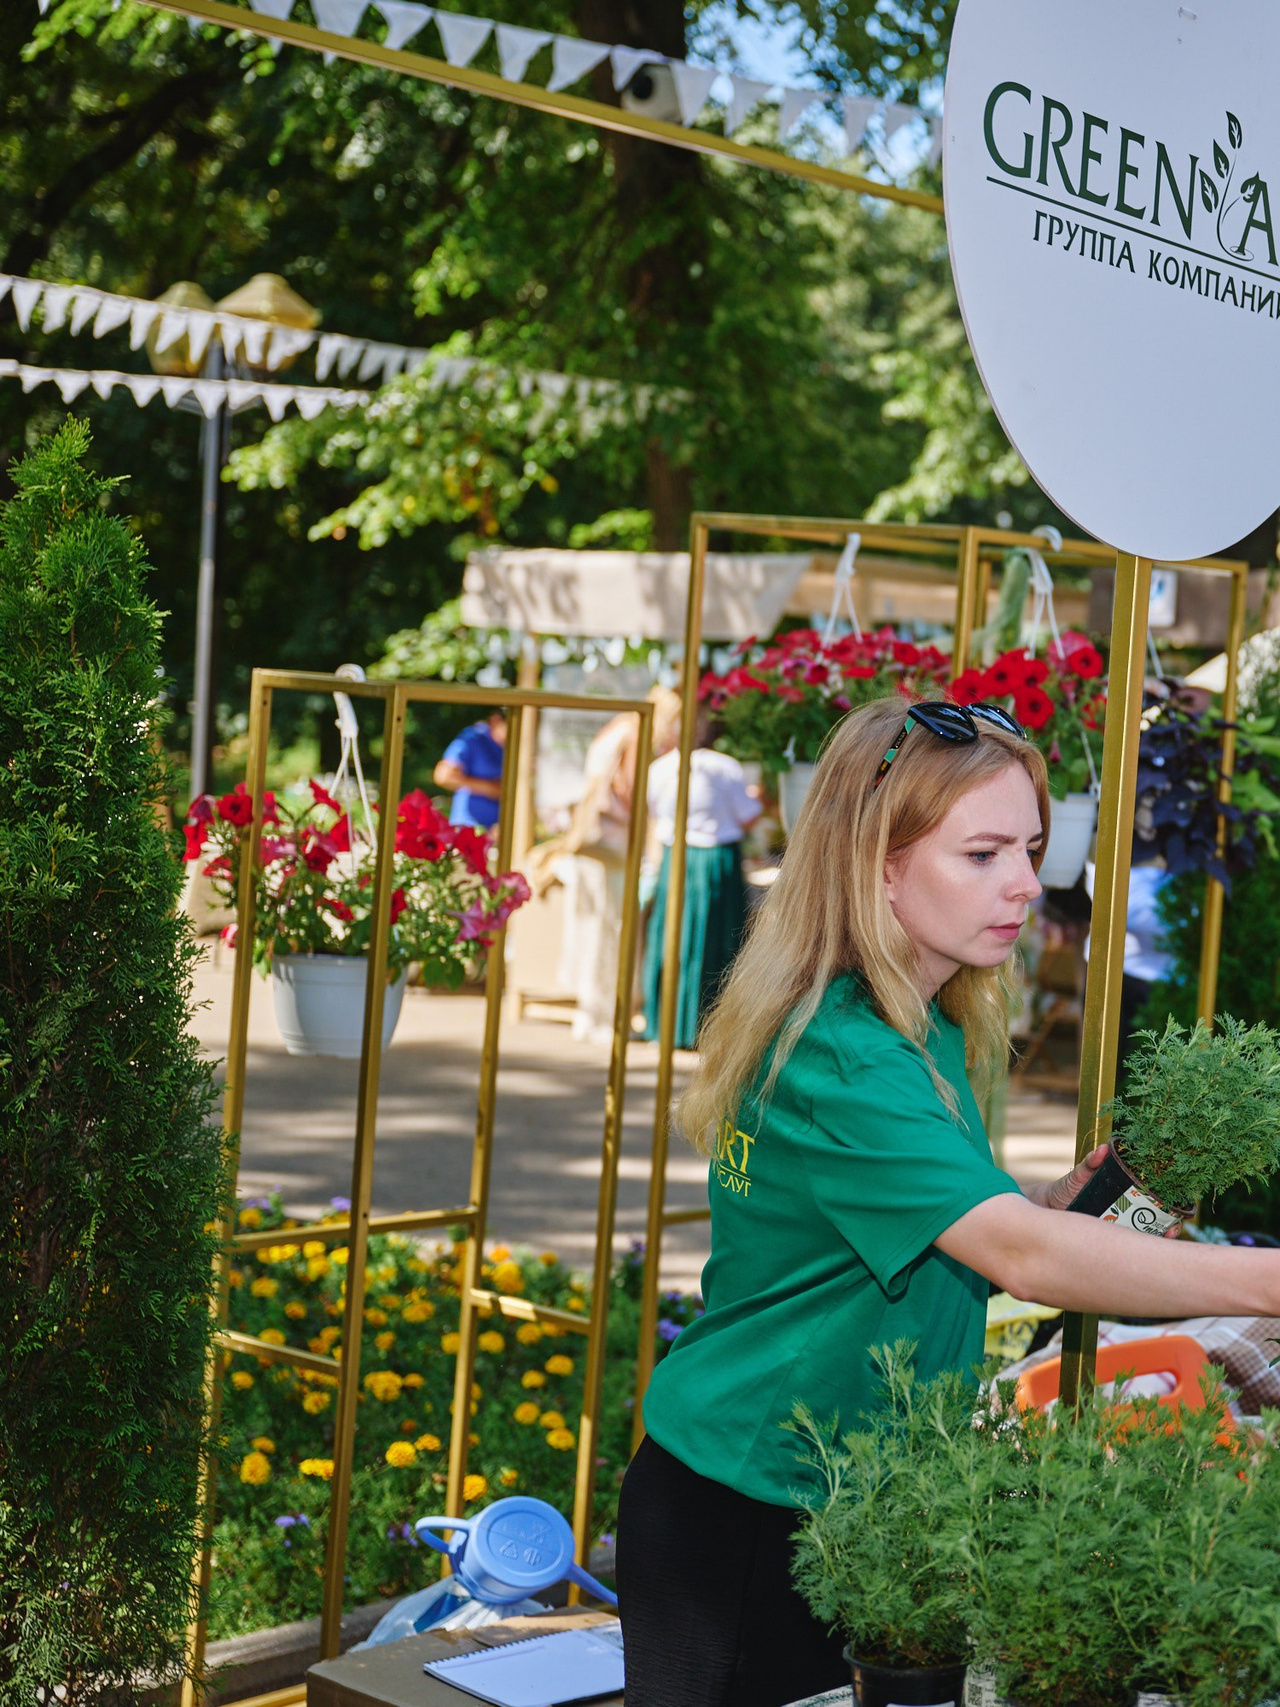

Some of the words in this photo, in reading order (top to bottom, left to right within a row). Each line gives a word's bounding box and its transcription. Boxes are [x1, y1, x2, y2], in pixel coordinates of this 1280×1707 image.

[984, 82, 1198, 239] GREEN
[1034, 210, 1135, 273] ГРУППА
[714, 1168, 752, 1198] СЛУГ
